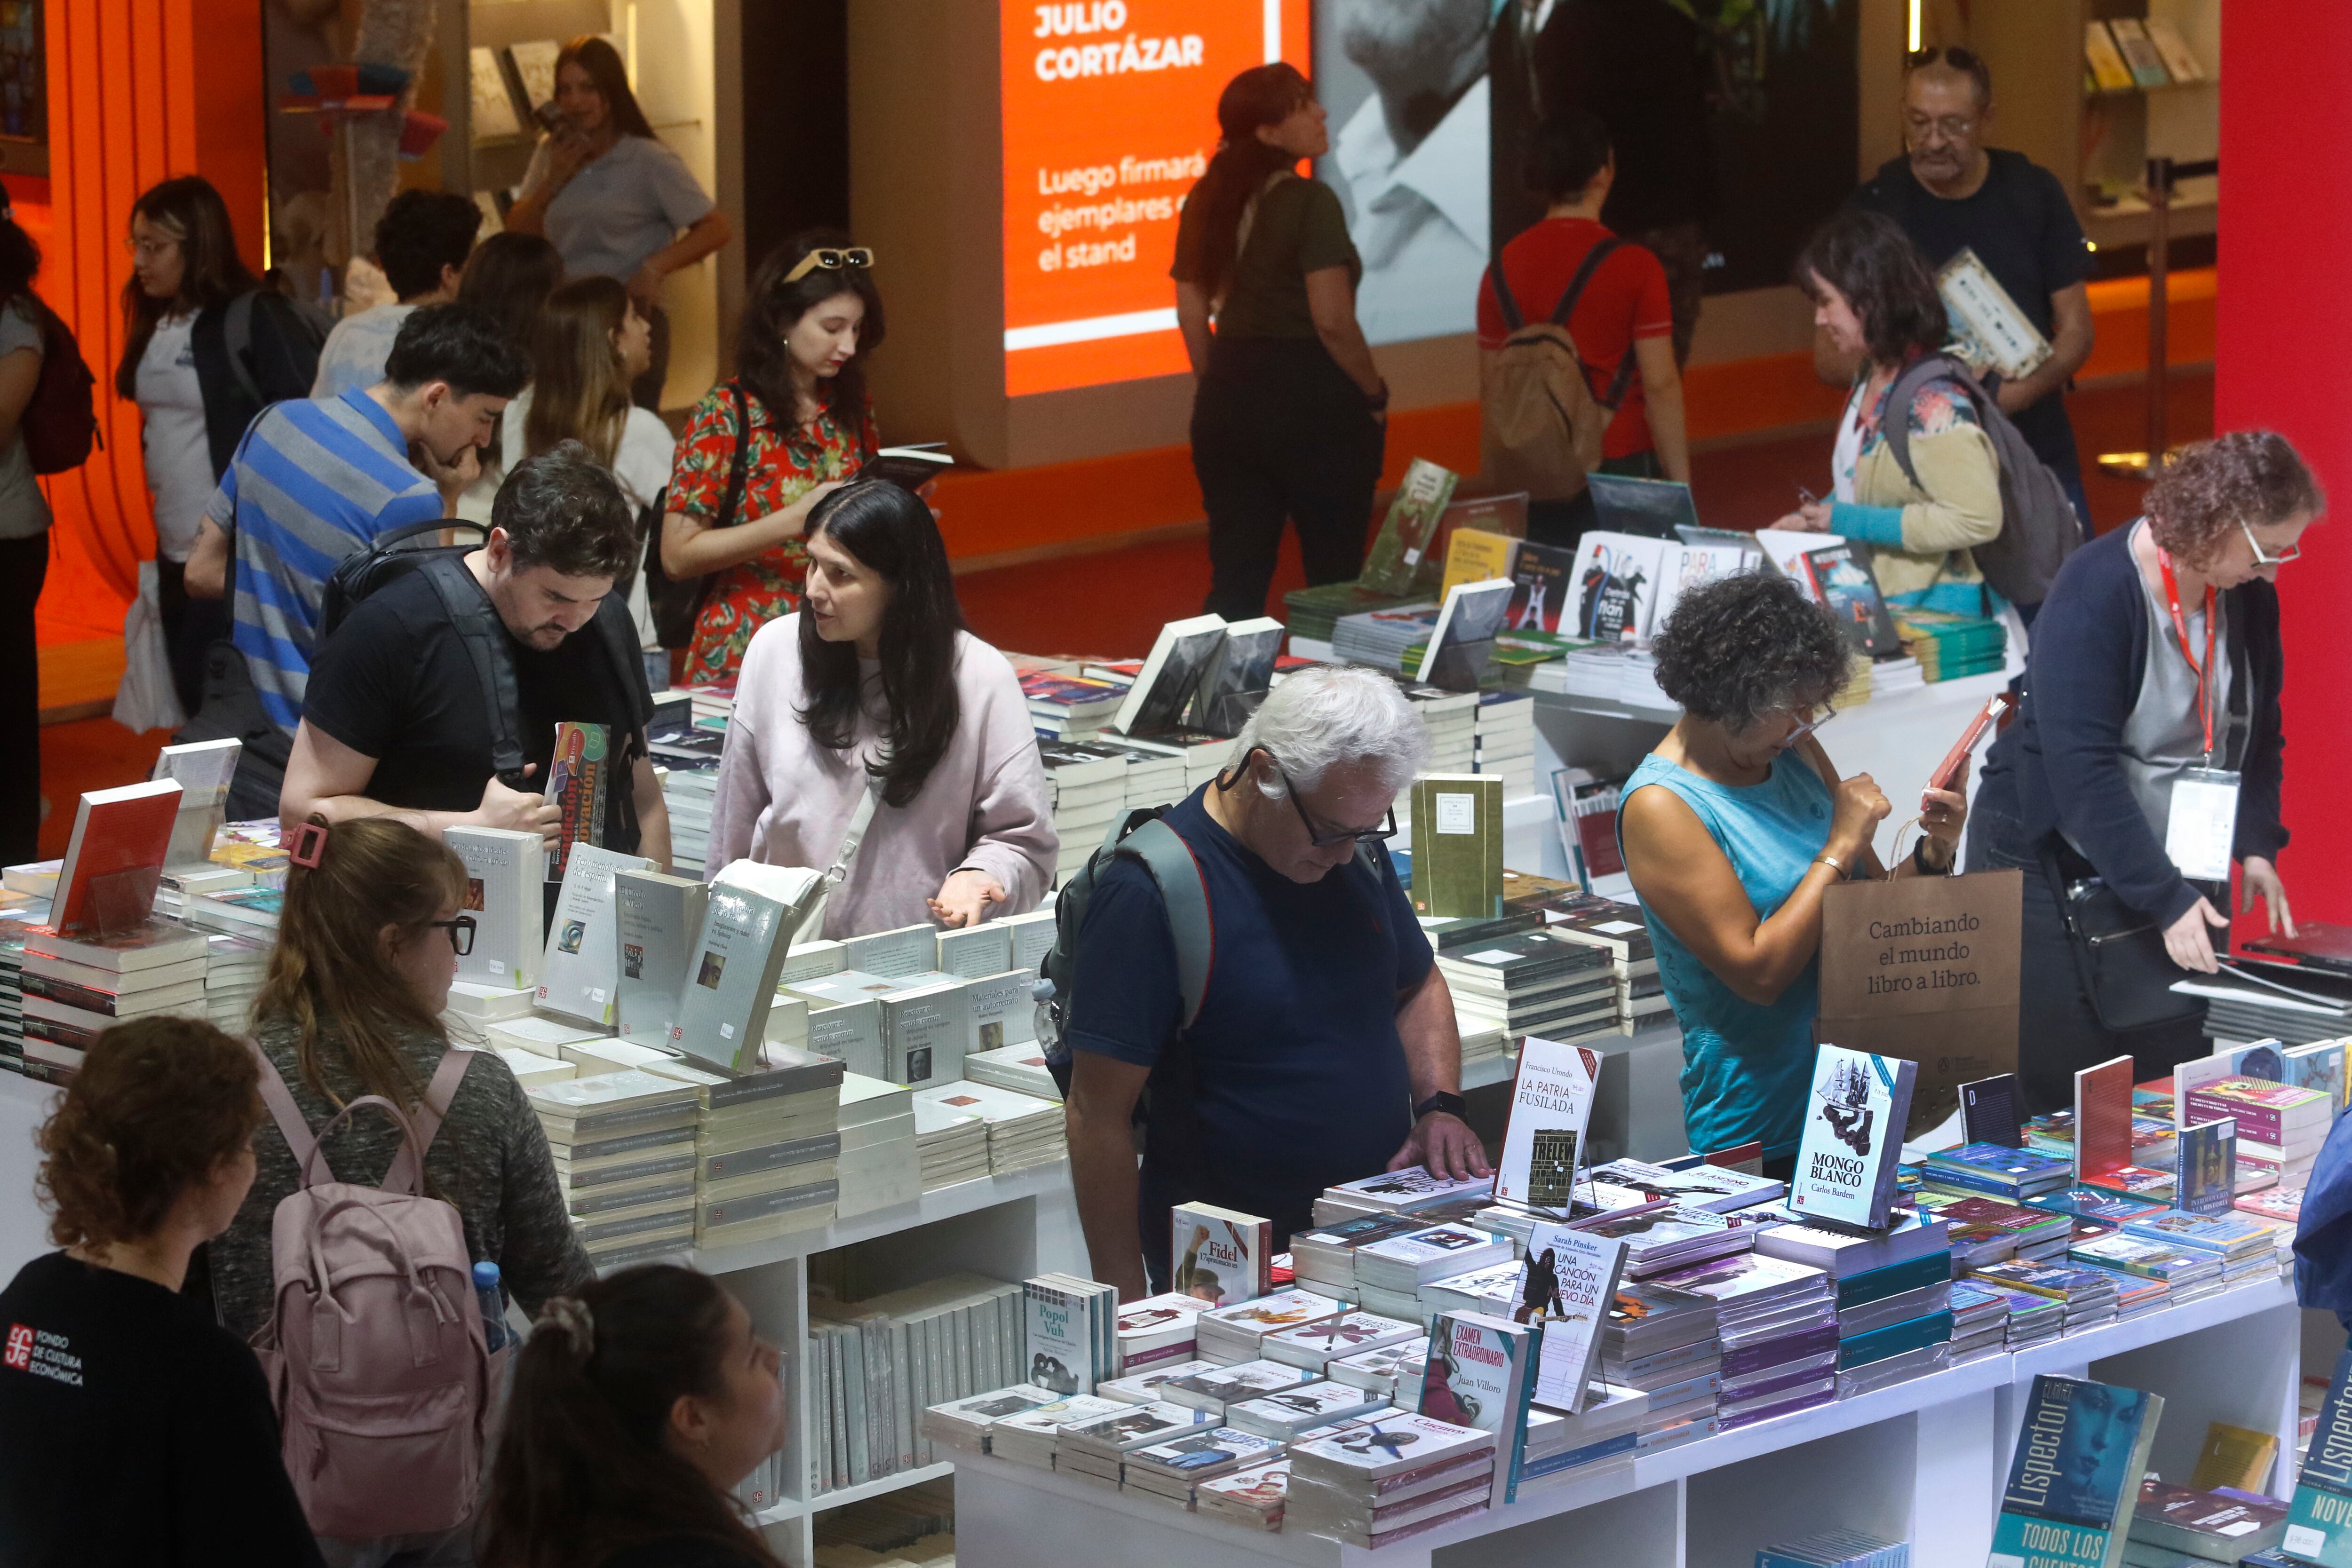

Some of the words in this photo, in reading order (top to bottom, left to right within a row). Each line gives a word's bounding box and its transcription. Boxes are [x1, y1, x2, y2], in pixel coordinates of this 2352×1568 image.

[1034, 1, 1127, 37] JULIO
[1035, 33, 1203, 81] CORTÁZAR
[1038, 166, 1116, 195] Luego
[1120, 149, 1206, 185] firmará
[1038, 195, 1173, 239] ejemplares
[1038, 243, 1062, 271] el
[1065, 234, 1136, 269] stand
[1680, 551, 1716, 572] PARA
[1598, 600, 1623, 617] flan
[486, 845, 508, 855] ideales
[468, 854, 489, 863] cultura
[490, 856, 510, 866] griega
[573, 866, 583, 876] del
[621, 886, 626, 895] El
[621, 897, 626, 906] de
[628, 898, 644, 910] Viena
[714, 907, 721, 915] de
[722, 909, 727, 918] lo
[1869, 913, 1979, 940] Cambiando
[1880, 947, 1894, 965] el
[1899, 942, 1970, 964] mundo
[1867, 975, 1912, 995] libro
[1916, 977, 1927, 990] a
[1931, 969, 1980, 989] libro.
[972, 989, 1003, 1002] Materiales
[1005, 987, 1018, 997] para
[983, 997, 1018, 1011] autorretrato
[900, 1007, 925, 1018] Reactivar
[900, 1018, 920, 1029] sentido
[922, 1014, 940, 1024] común
[812, 1022, 838, 1032] Reactivar
[813, 1034, 833, 1043] sentido
[834, 1029, 853, 1039] común
[1526, 1061, 1550, 1074] Francisco
[1552, 1067, 1573, 1078] Urondo
[1521, 1078, 1533, 1091] LA
[1537, 1081, 1569, 1099] PATRIA
[1969, 1090, 1976, 1106] D
[1518, 1092, 1574, 1114] FUSILADA
[1533, 1142, 1576, 1161] TRELEW
[1812, 1152, 1864, 1174] MONGO
[1706, 1174, 1752, 1186] ASESINO
[1810, 1166, 1862, 1188] BLANCO
[1811, 1183, 1830, 1195] Carlos
[1832, 1188, 1855, 1200] Bardem
[1669, 1205, 1728, 1220] MUJERES
[2203, 1199, 2228, 1211] HISTORIA
[1209, 1241, 1238, 1262] Fidel
[1553, 1235, 1572, 1245] Sarah
[1573, 1239, 1598, 1251] Pinsker
[1200, 1252, 1207, 1261] 17
[1557, 1252, 1577, 1266] UNA
[1554, 1264, 1597, 1283] CANCIÓN
[1561, 1277, 1582, 1291] PARA
[1585, 1283, 1599, 1295] UN
[1547, 1287, 1579, 1302] NUEVO
[1580, 1293, 1595, 1307] DÍA
[1039, 1304, 1069, 1324] Popol
[1044, 1320, 1064, 1338] Vuh
[1455, 1324, 1482, 1345] EXAMEN
[36, 1330, 69, 1349] FONDO
[32, 1345, 45, 1359] DE
[44, 1348, 81, 1370] CULTURA
[1453, 1341, 1505, 1368] EXTRAORDINARIO
[28, 1360, 83, 1386] ECONÓMICA
[1457, 1374, 1474, 1387] Juan
[1476, 1378, 1501, 1394] Villoro
[1414, 1418, 1468, 1434] Cuentos
[2004, 1398, 2069, 1506] Lispector
[2022, 1522, 2071, 1554] TODOS
[2073, 1532, 2103, 1560] LOS
